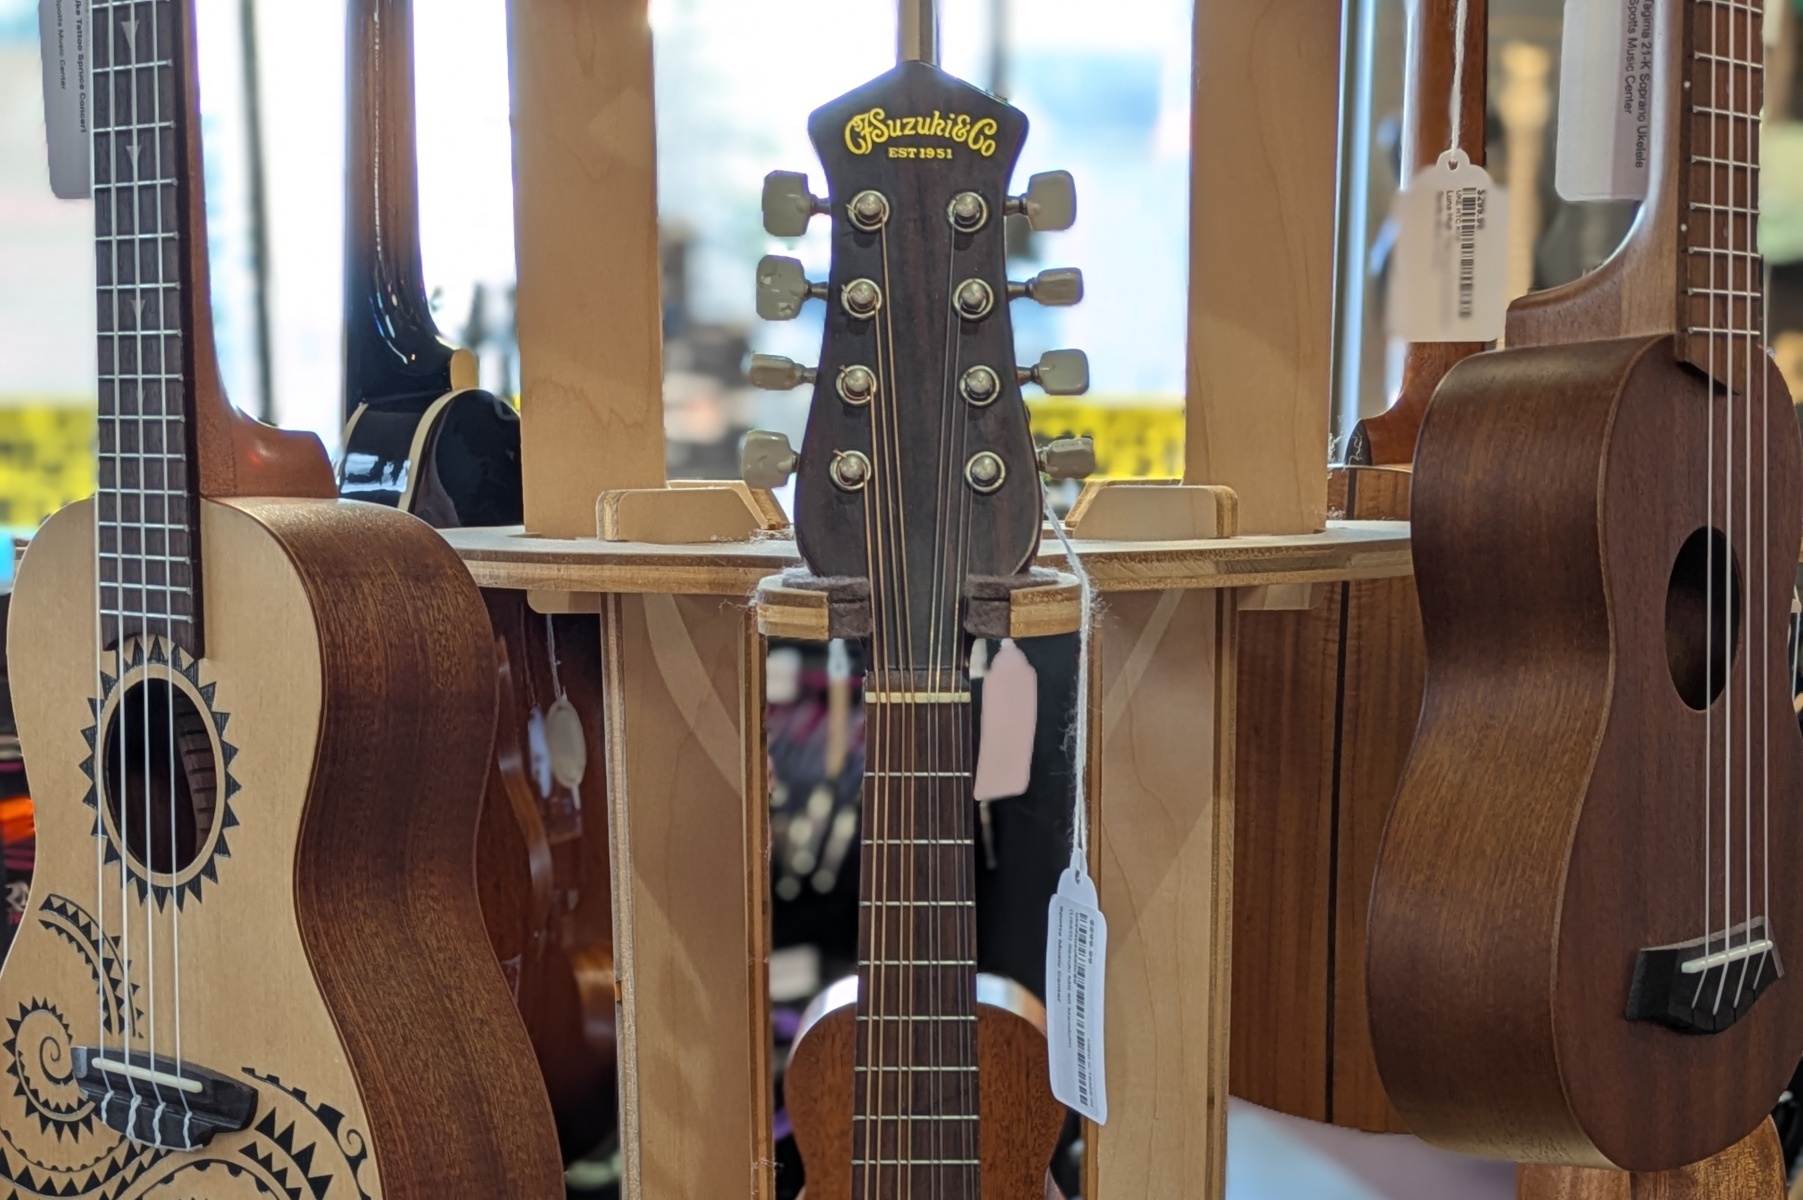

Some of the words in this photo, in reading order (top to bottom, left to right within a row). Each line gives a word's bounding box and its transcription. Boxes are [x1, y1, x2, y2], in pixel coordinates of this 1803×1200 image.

[1627, 0, 1639, 34] Spotts
[77, 53, 85, 90] Spruce
[1625, 37, 1638, 72] Music
[1640, 42, 1652, 69] 21-K
[79, 92, 87, 133] Concert
[1624, 75, 1636, 114] Center
[1637, 73, 1650, 122] Soprano
[888, 147, 917, 159] EST
[920, 147, 953, 159] 1951
[1634, 125, 1648, 168] Ukelele
